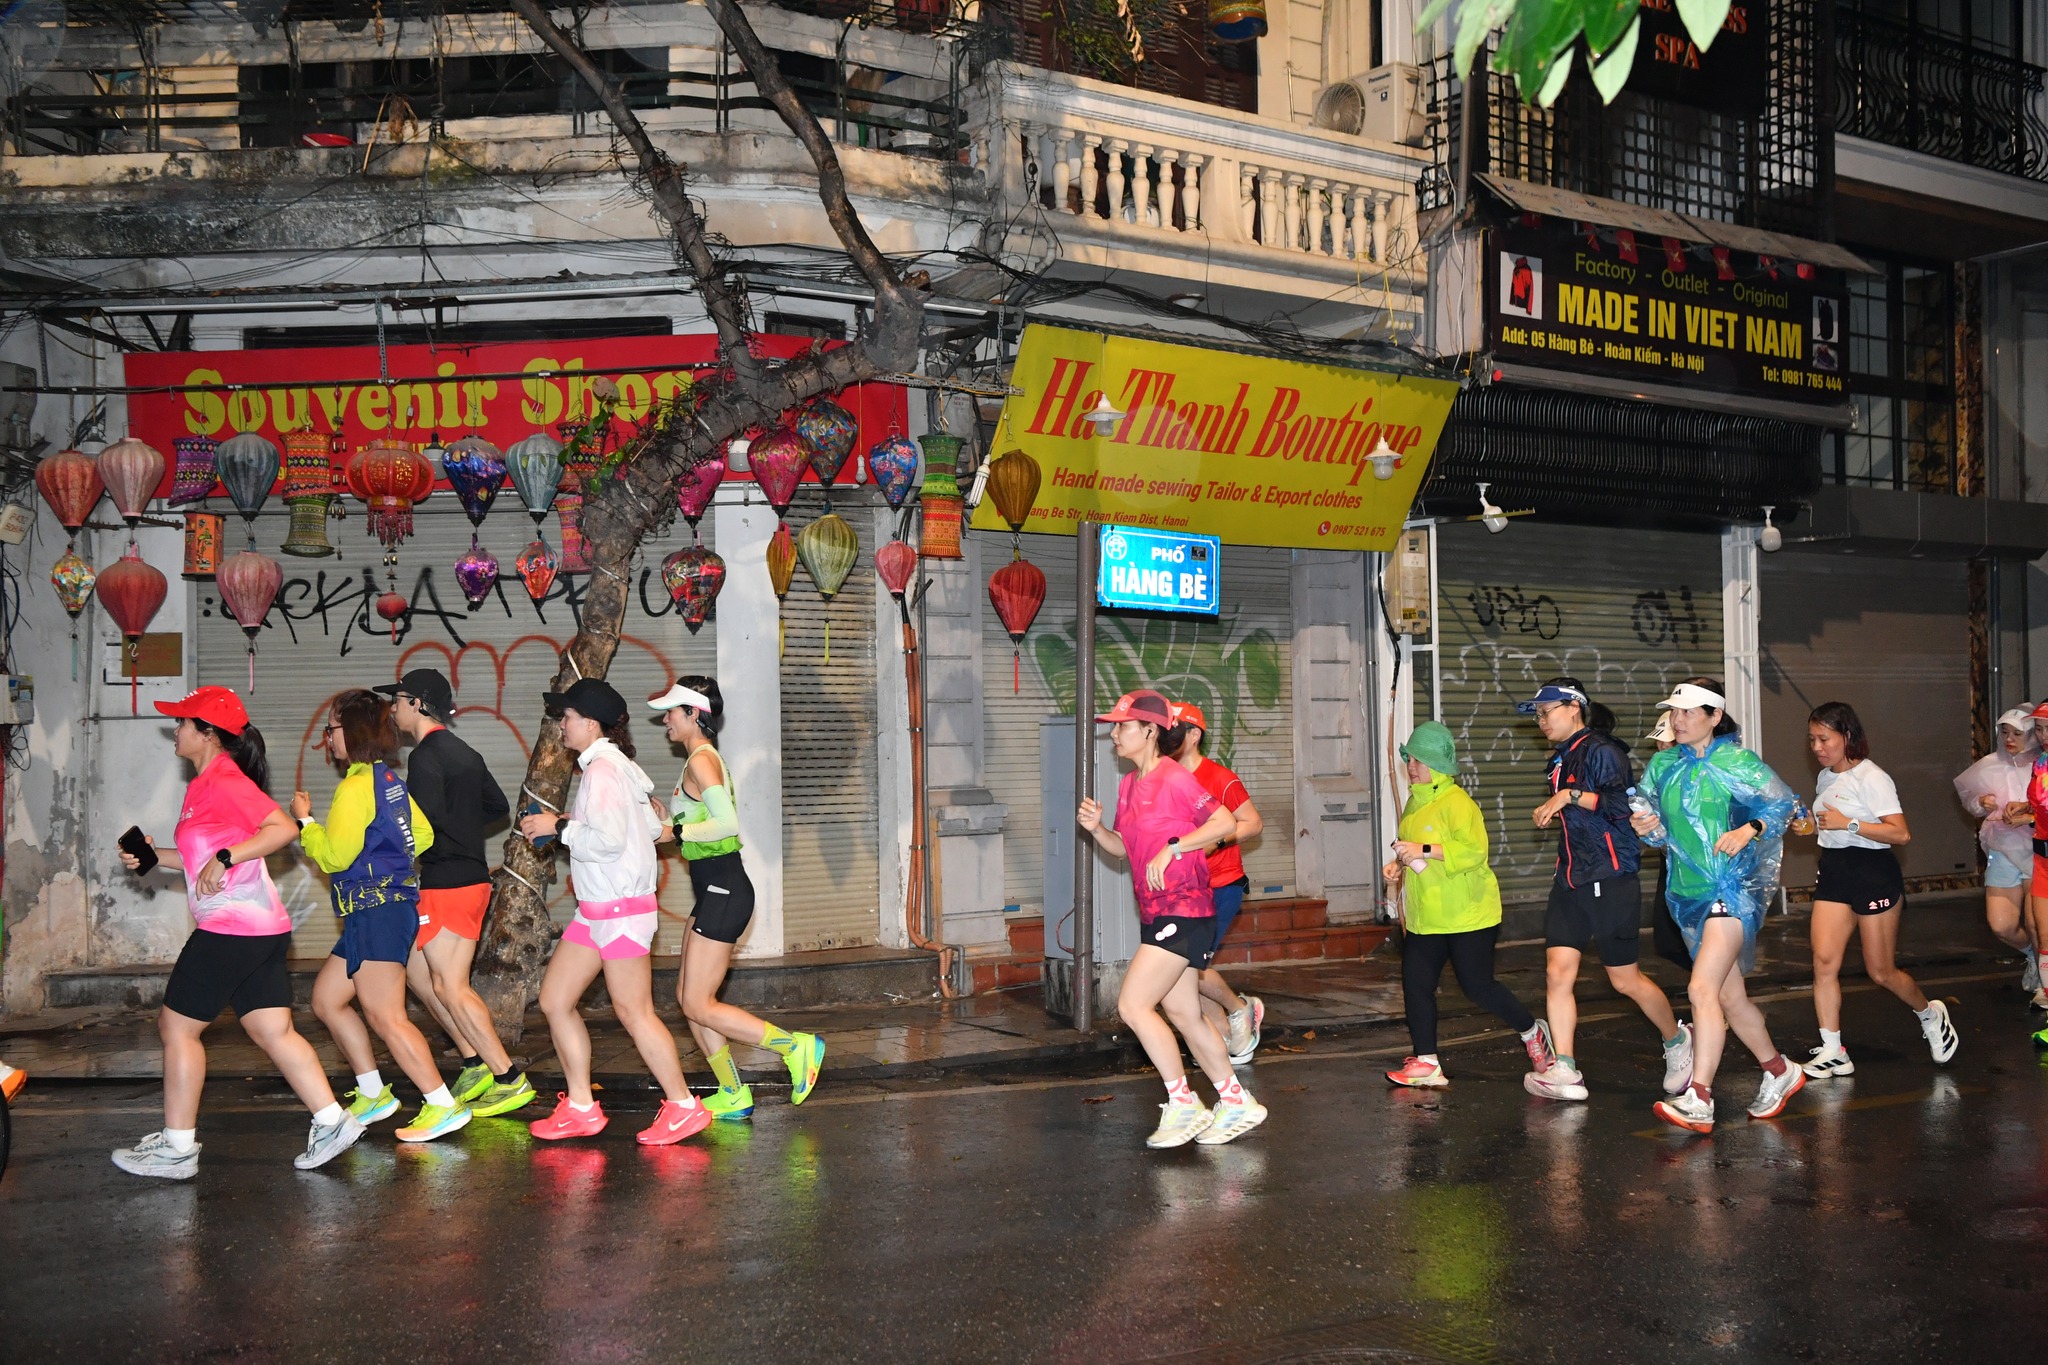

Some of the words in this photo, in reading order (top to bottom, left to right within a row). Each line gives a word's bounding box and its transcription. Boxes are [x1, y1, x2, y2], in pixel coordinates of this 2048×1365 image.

[1655, 33, 1700, 70] SPA
[1575, 252, 1636, 285] Factory
[1661, 269, 1709, 295] Outlet
[1732, 282, 1788, 309] Original
[1558, 282, 1639, 334] MADE
[1648, 298, 1676, 340] IN
[1684, 304, 1738, 349] VIET
[1746, 315, 1802, 360] NAM
[1502, 326, 1528, 346] Add:
[1531, 330, 1546, 348] 05
[1548, 333, 1576, 355] Hàng
[1579, 338, 1594, 356] Bè
[1604, 342, 1631, 361] Hoàn
[1634, 345, 1661, 366] Kiếm
[1671, 351, 1685, 369] Hà
[1687, 354, 1705, 374] Nội
[183, 362, 498, 435] Souvenir
[521, 357, 693, 432] Shop
[1762, 365, 1780, 383] Tel:
[1782, 369, 1803, 386] 0981
[1806, 372, 1823, 388] 765
[1825, 375, 1842, 392] 444
[1024, 357, 1104, 440] Ha
[1109, 368, 1250, 455] Thanh
[1245, 387, 1422, 487] Boutique
[1052, 467, 1099, 489] Hand
[1099, 474, 1144, 494] made
[1147, 478, 1202, 502] sewing
[1205, 481, 1249, 503] Tailor
[1250, 485, 1262, 502] &
[1264, 485, 1312, 509] Export
[1313, 493, 1363, 509] clothes
[1030, 507, 1049, 519] ang
[1051, 507, 1065, 518] Be
[1067, 508, 1083, 521] Str,
[1086, 509, 1112, 523] Hoan
[1113, 512, 1137, 524] Kiem
[1138, 514, 1160, 526] Dist,
[1161, 515, 1189, 527] Hanoi
[1333, 524, 1352, 535] 0987
[1354, 526, 1369, 536] 521
[1371, 527, 1386, 537] 675
[1151, 544, 1187, 564] PHỐ
[1111, 561, 1173, 598] HÀNG
[1179, 568, 1208, 601] BÈ
[1878, 898, 1890, 908] T8
